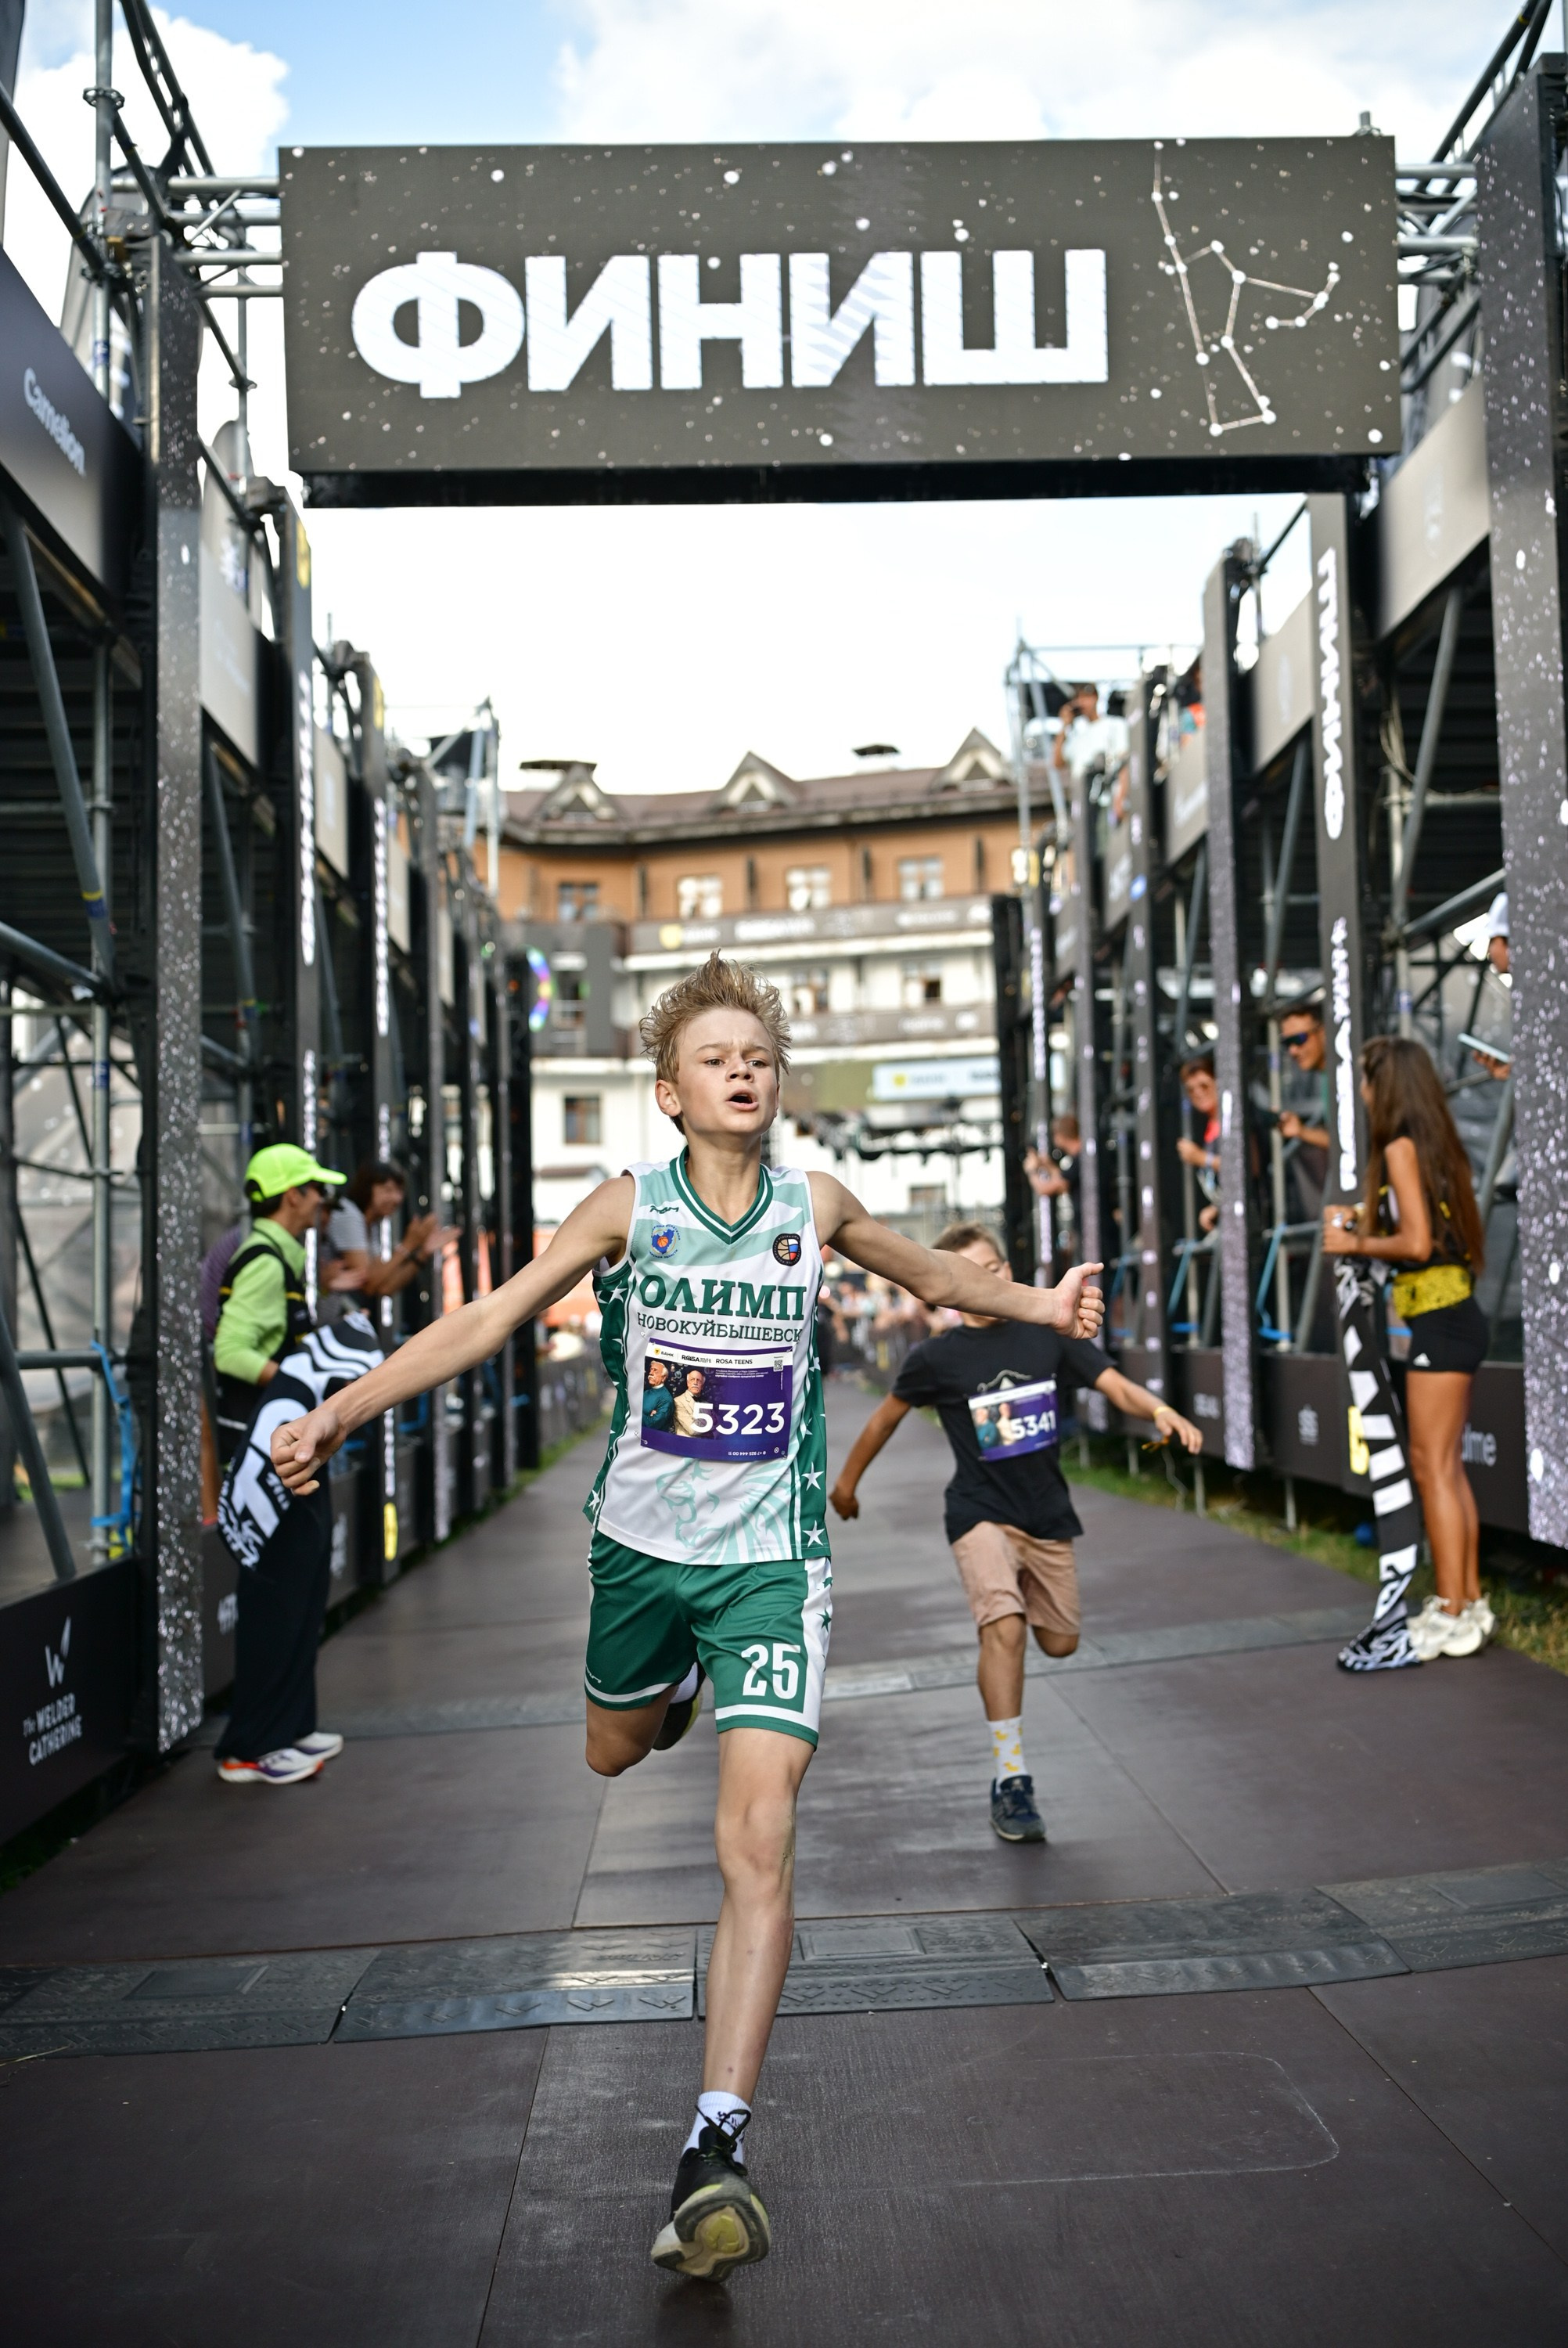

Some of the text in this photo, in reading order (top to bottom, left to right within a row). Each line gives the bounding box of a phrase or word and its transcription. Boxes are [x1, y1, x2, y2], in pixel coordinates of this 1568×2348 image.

[351, 248, 1109, 399] ФИНИШ
[639, 1274, 807, 1321] ОЛИМП
[637, 1312, 804, 1343] НОВОКУЙБЫШЕВСК
[690, 1402, 785, 1435] 5323
[1009, 1410, 1056, 1440] 5341
[740, 1642, 801, 1700] 25
